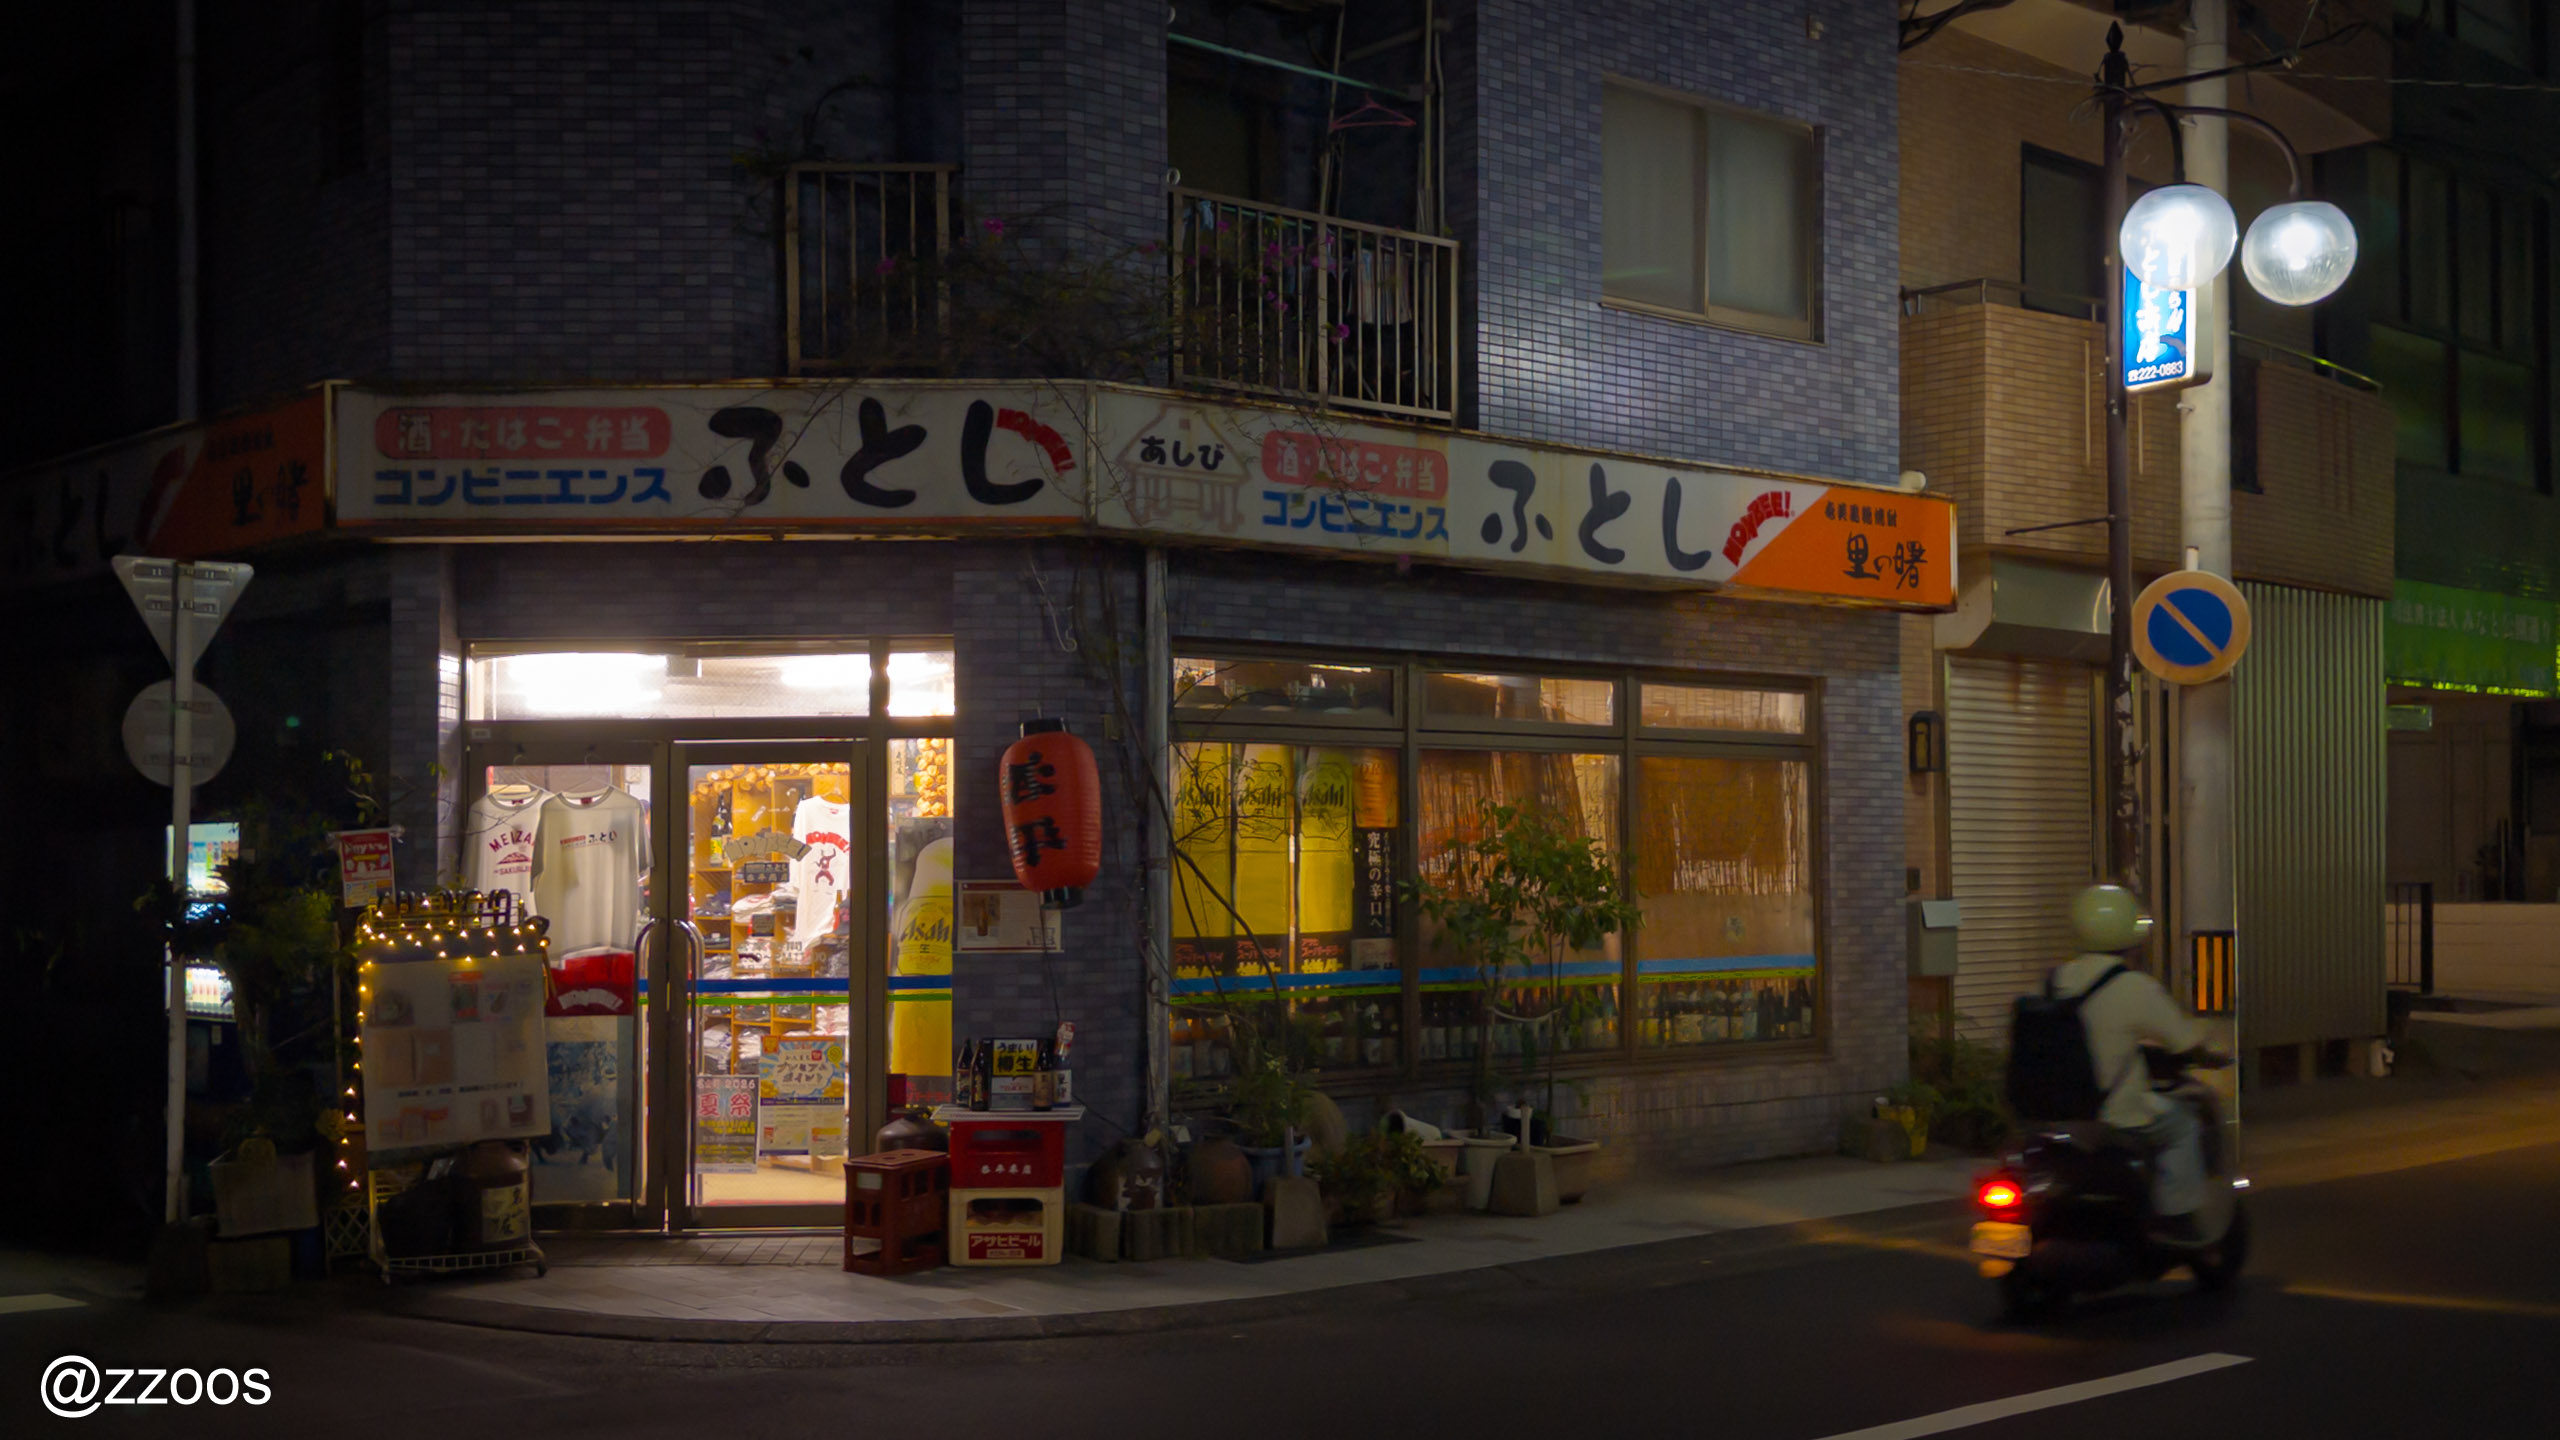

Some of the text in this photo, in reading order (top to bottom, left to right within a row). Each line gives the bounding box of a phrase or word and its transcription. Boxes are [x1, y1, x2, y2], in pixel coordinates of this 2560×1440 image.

[698, 397, 1044, 507] ふとし
[1141, 435, 1224, 471] あしび
[374, 467, 671, 506] コンビニエンス
[1262, 490, 1449, 542] コンビニエンス
[1481, 460, 1711, 571] ふとし
[1842, 531, 1928, 590] 里の曙
[970, 1234, 1041, 1248] アサヒビール
